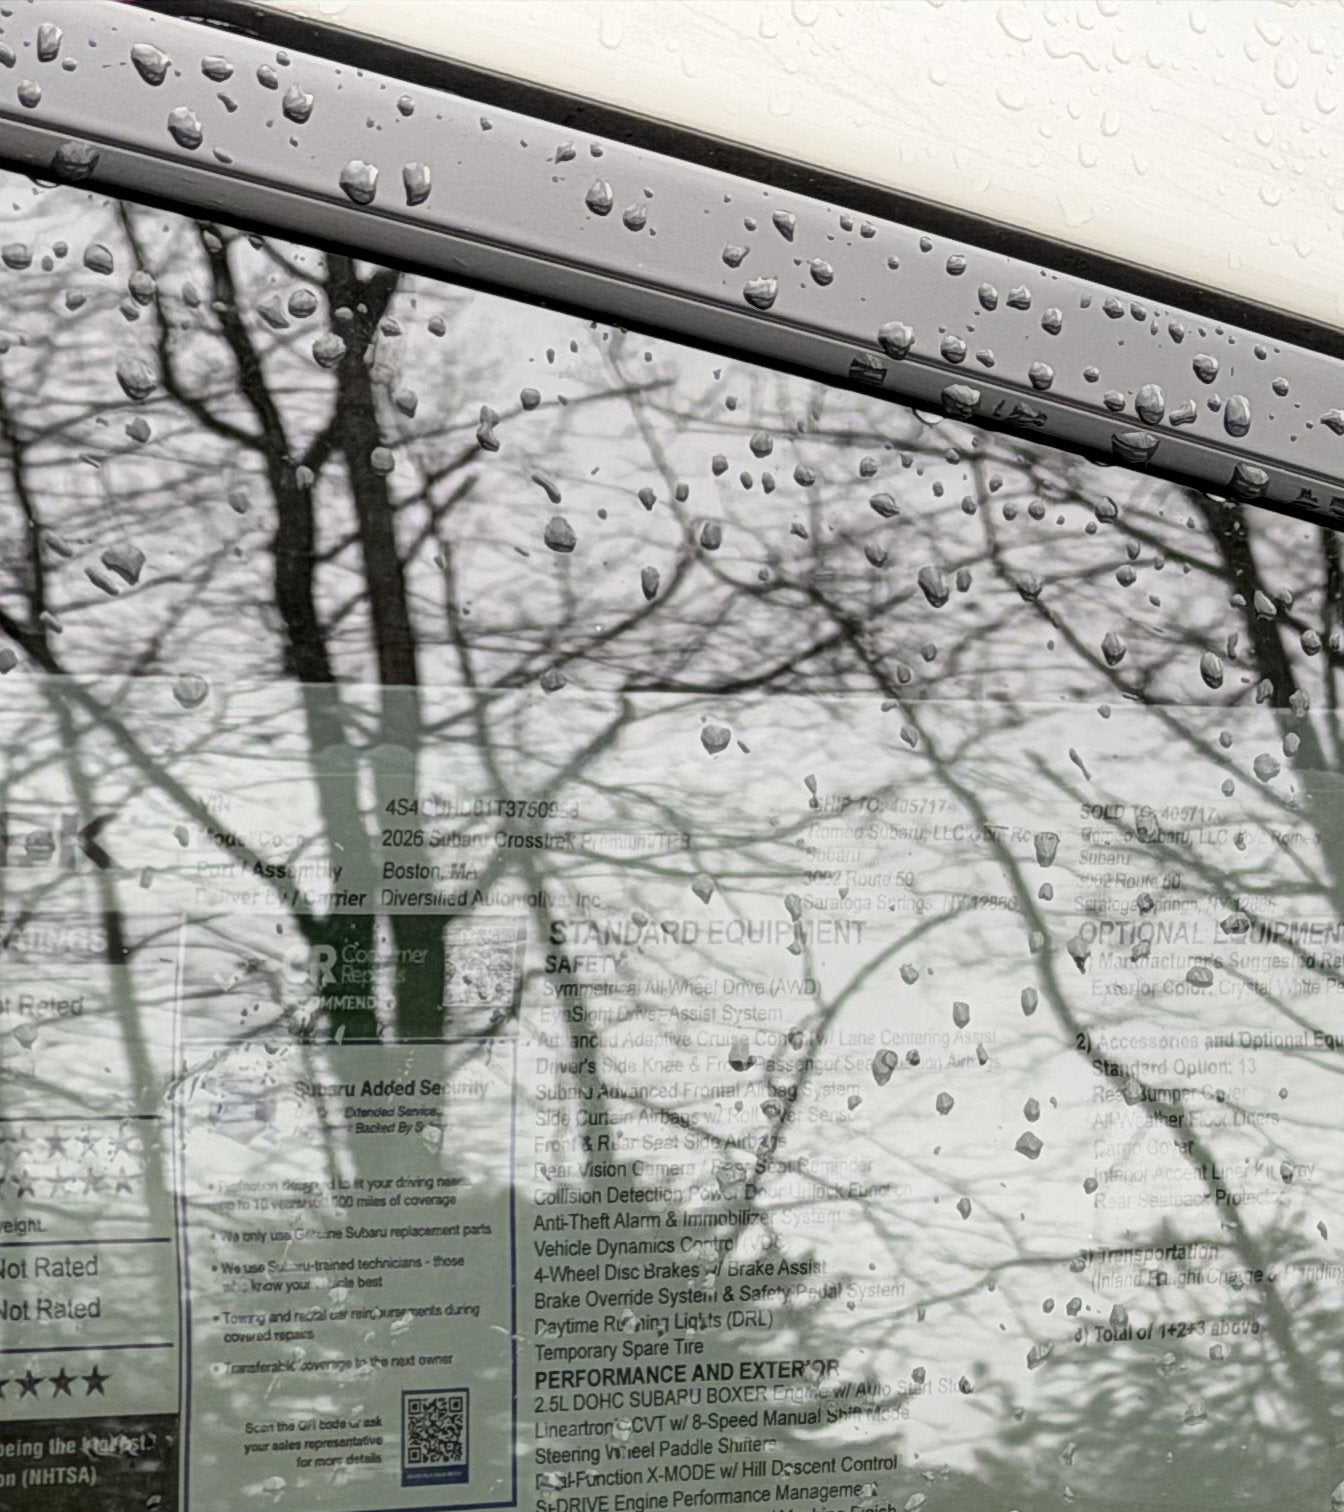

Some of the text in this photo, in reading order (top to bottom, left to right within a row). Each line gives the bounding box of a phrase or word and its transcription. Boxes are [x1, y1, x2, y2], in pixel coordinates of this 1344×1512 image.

[550, 920, 867, 947] STANDARD EQUIPMENT
[35, 1256, 98, 1277] Rated
[37, 1297, 101, 1320] Rated
[534, 1337, 705, 1364] Temporary Spare Tire
